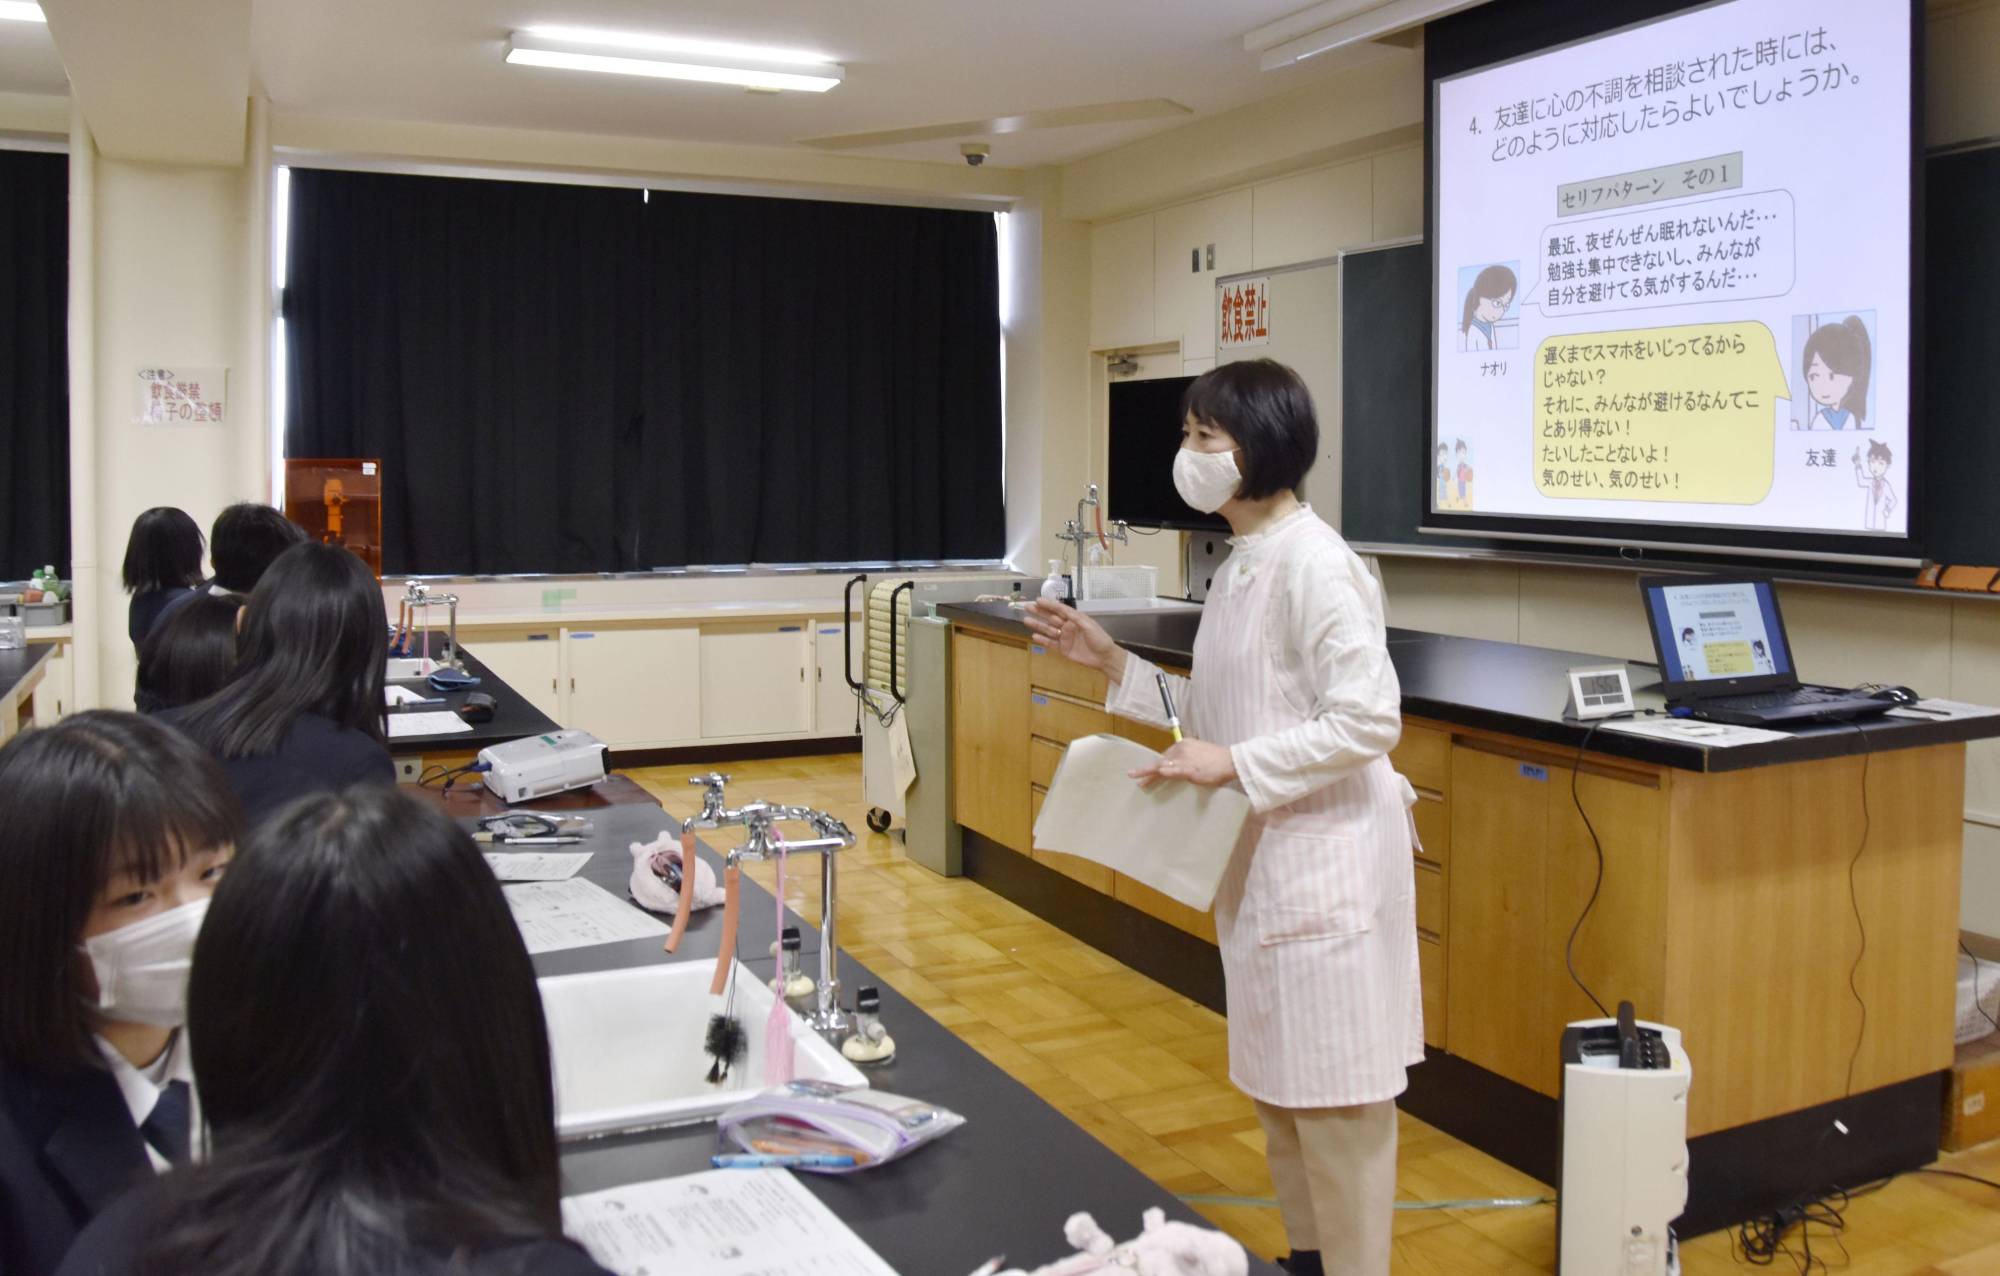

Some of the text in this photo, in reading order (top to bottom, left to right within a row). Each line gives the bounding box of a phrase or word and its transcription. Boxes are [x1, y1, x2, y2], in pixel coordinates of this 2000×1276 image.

[1494, 26, 1837, 131] 友達に心の不調を相談された時には、
[1491, 62, 1860, 162] どのように対応したらよいでしょうか。
[1562, 177, 1666, 209] セリフパターン
[1547, 235, 1761, 282] 勉強も集中できないし、みんなが
[1222, 282, 1267, 342] 飲食禁止
[1544, 333, 1746, 365] 遅くまでスマホをいじってるから
[1480, 361, 1507, 376] ナオリ
[1544, 390, 1760, 415] それに、みんなが避けるなんてこ
[1805, 448, 1837, 467] 友達
